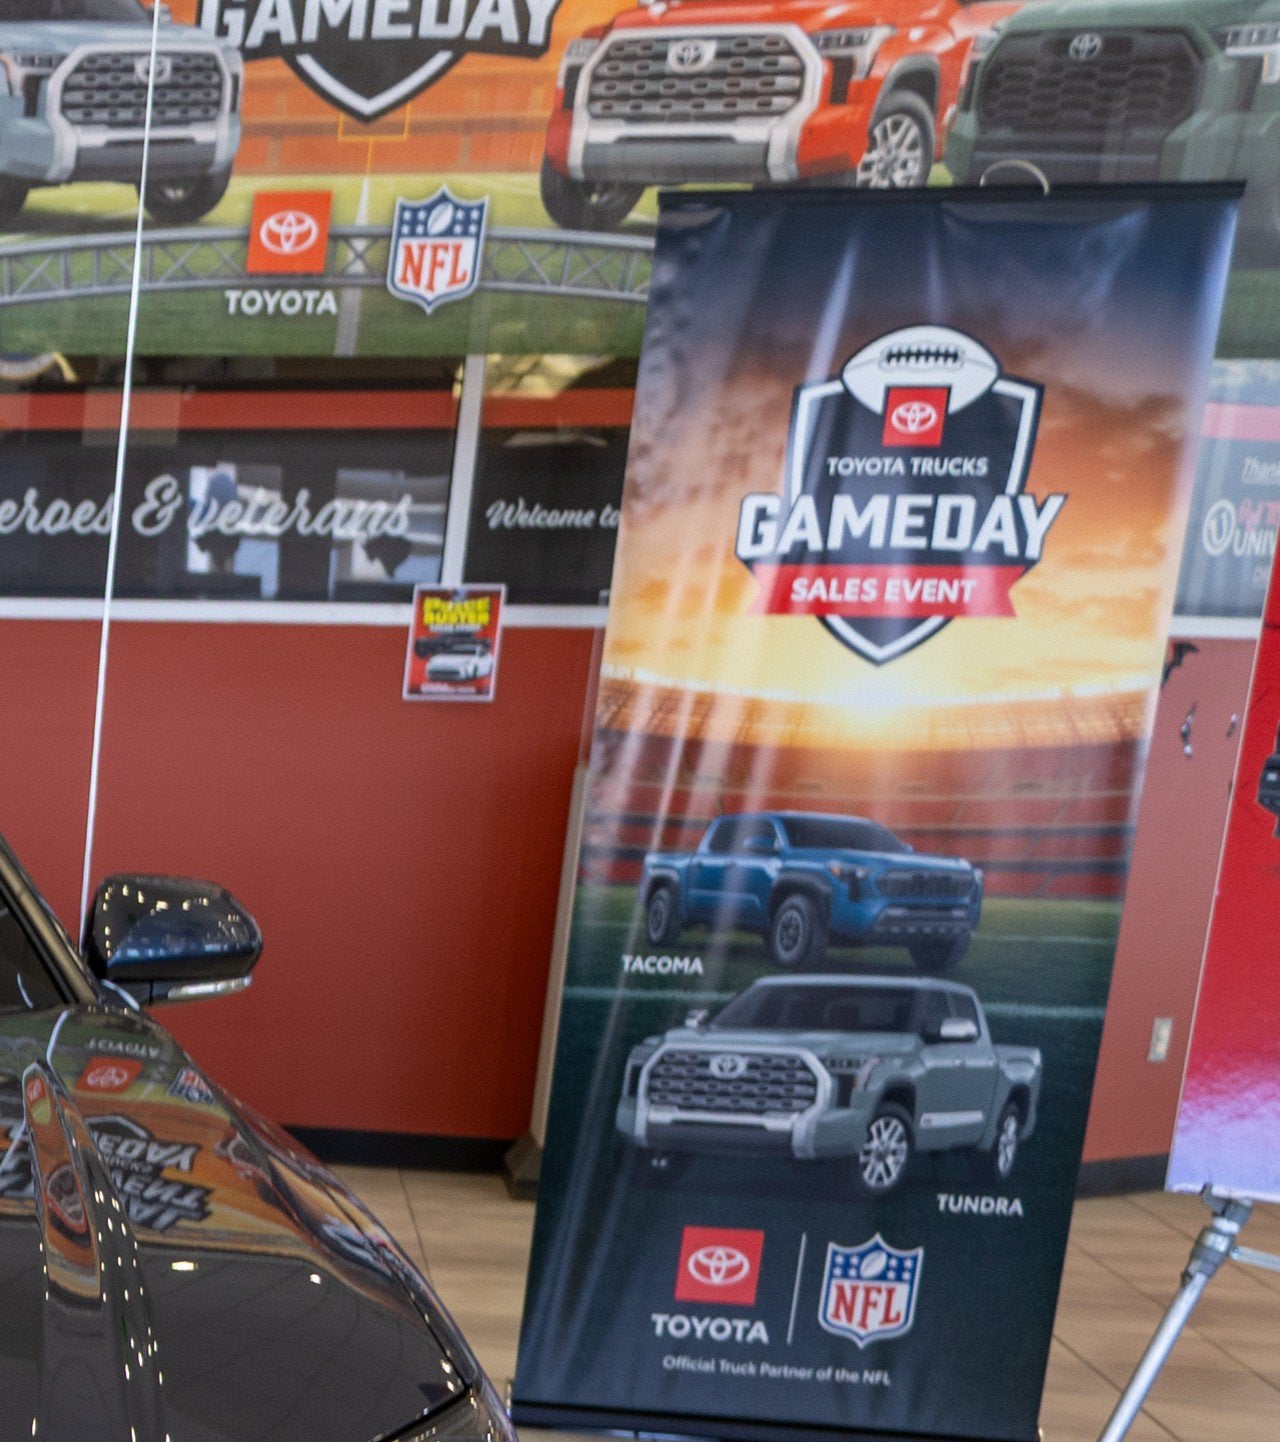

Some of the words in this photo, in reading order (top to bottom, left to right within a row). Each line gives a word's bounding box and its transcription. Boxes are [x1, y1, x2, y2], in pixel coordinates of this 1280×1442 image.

[198, 0, 561, 48] GAMEDAY
[397, 242, 469, 293] NFL
[225, 289, 338, 316] TOYOTA
[826, 457, 906, 477] TOYOTA
[910, 456, 989, 477] TRUCKS
[131, 473, 183, 537] &
[186, 486, 415, 538] veterans
[485, 496, 596, 531] Welcome
[738, 492, 1068, 561] GAMEDAY
[790, 577, 878, 602] SALES
[883, 578, 978, 603] EVENT
[621, 954, 705, 976] TACOMA
[936, 1193, 1024, 1217] TUNDRA
[830, 1282, 902, 1331] NFL
[650, 1313, 770, 1345] TOYOTA
[662, 1354, 715, 1373] Official
[718, 1357, 757, 1376] Truck
[760, 1360, 813, 1380] Partner
[816, 1366, 834, 1382] of
[836, 1368, 860, 1384] the
[862, 1370, 891, 1387] NFL
